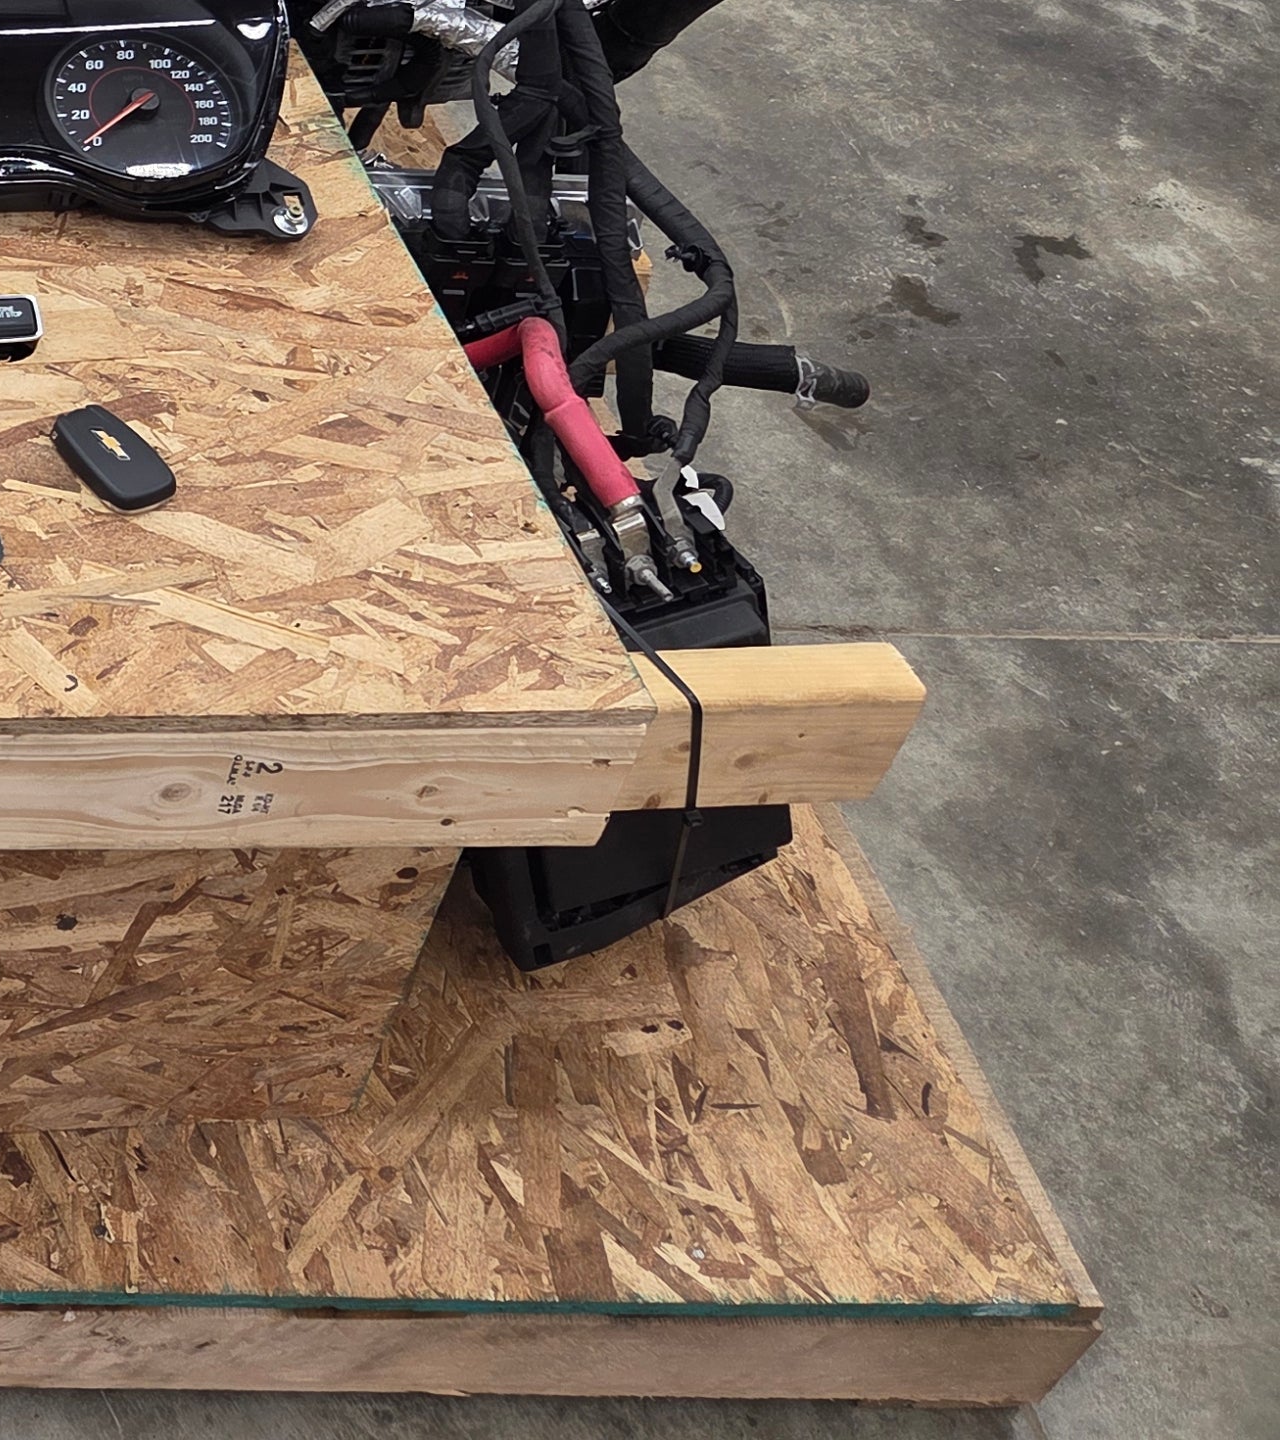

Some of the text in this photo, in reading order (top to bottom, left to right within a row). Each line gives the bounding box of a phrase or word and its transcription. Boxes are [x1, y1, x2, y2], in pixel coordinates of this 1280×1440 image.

[116, 49, 134, 60] 80
[85, 60, 104, 70] 60
[148, 59, 171, 69] 100
[170, 70, 190, 79] 120
[67, 82, 87, 93] 40
[183, 83, 204, 92] 140
[194, 100, 214, 109] 160
[71, 109, 90, 120] 20
[198, 116, 218, 126] 180
[92, 137, 102, 147] 0
[190, 133, 213, 144] 200
[255, 762, 283, 774] 2
[217, 795, 235, 814] 217
